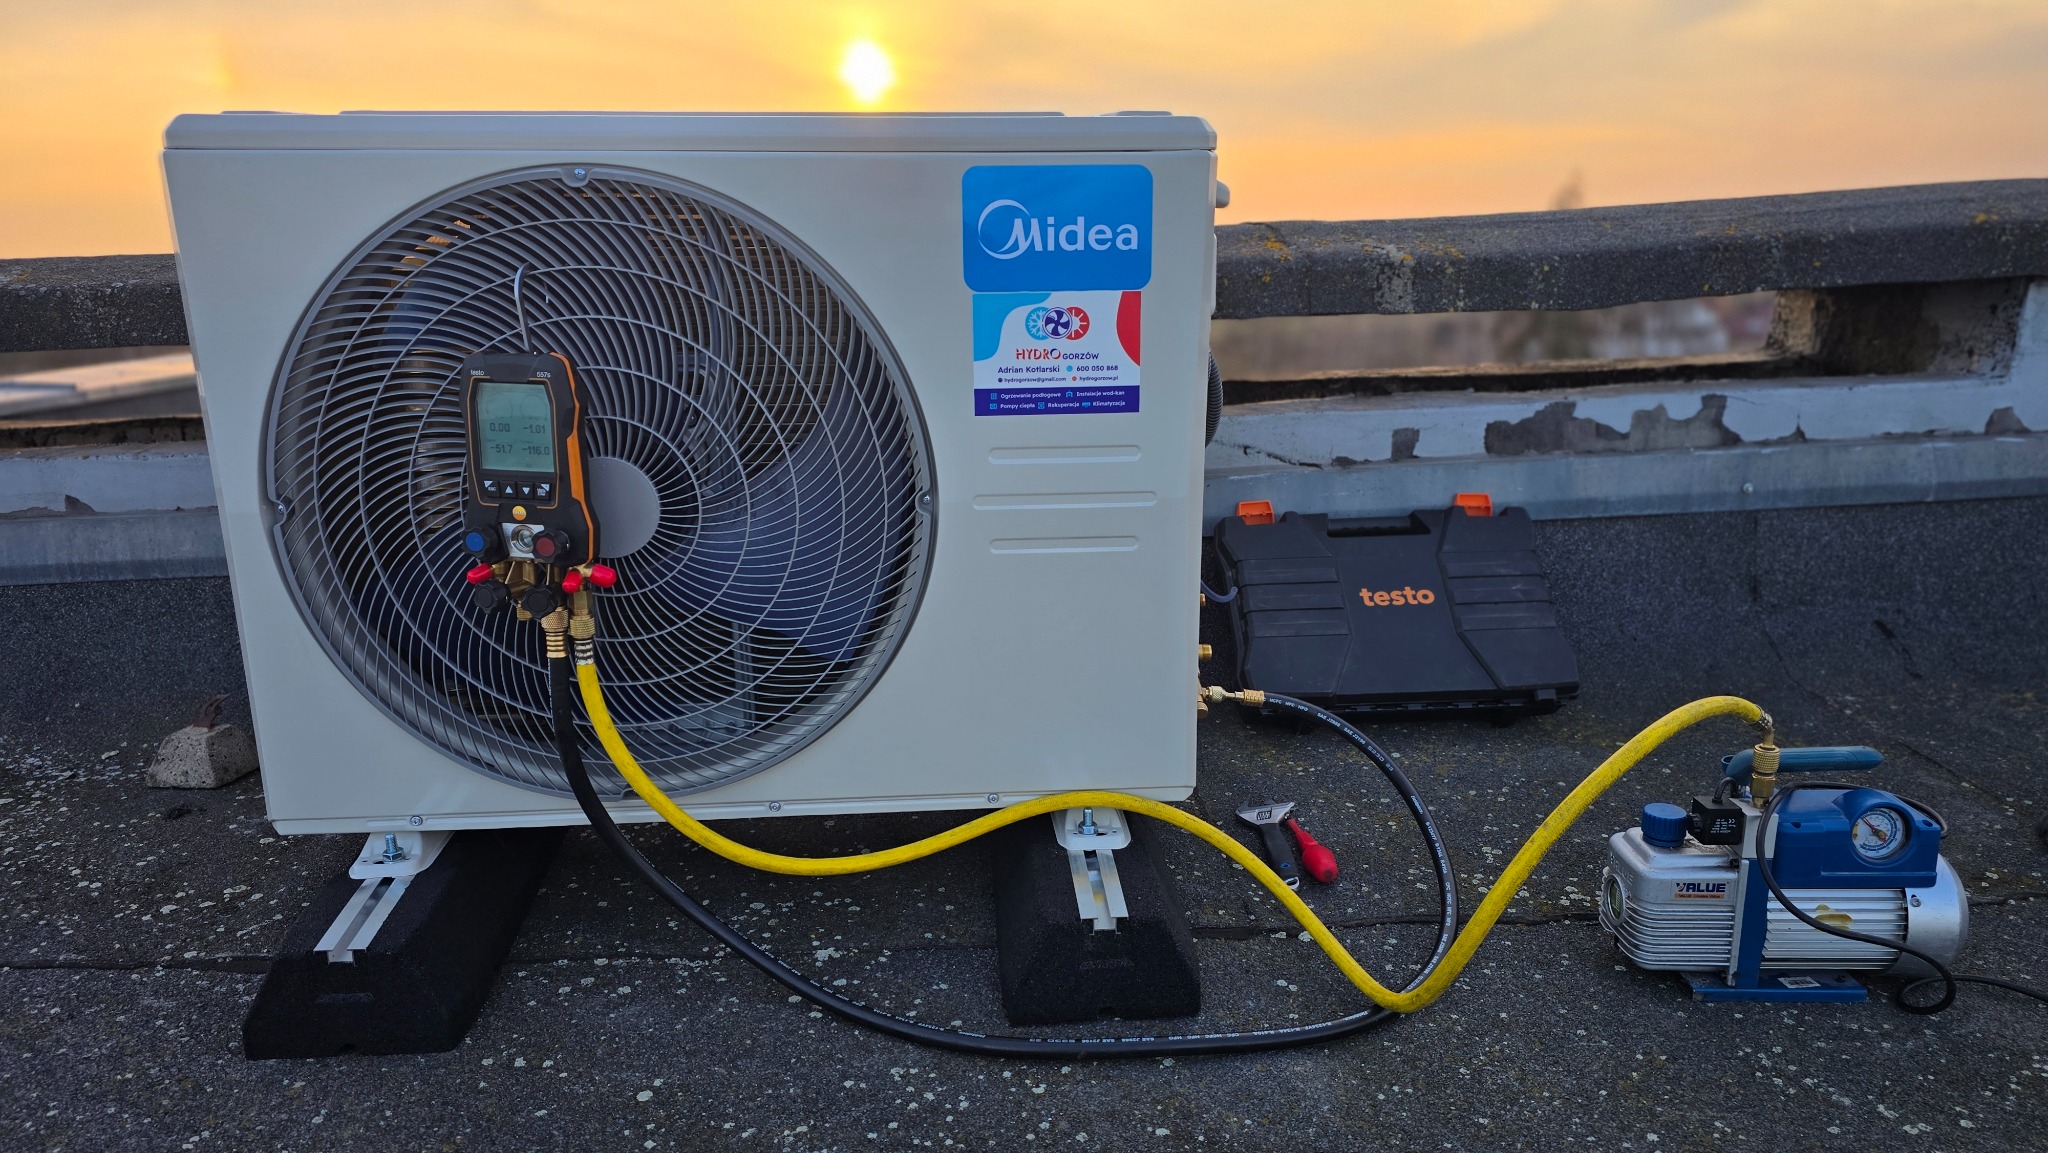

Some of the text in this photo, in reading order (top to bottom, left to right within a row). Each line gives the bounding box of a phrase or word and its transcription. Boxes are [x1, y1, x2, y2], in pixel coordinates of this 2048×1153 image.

[978, 214, 1138, 259] Midea
[1016, 348, 1099, 360] HYDRO GORZÓW
[998, 365, 1060, 374] Adrian Kotlarski
[489, 422, 546, 434] 0.00 -1.01
[489, 444, 550, 456] -51.7 -116.0
[1359, 586, 1435, 607] testo
[1675, 882, 1726, 893] VALUE
